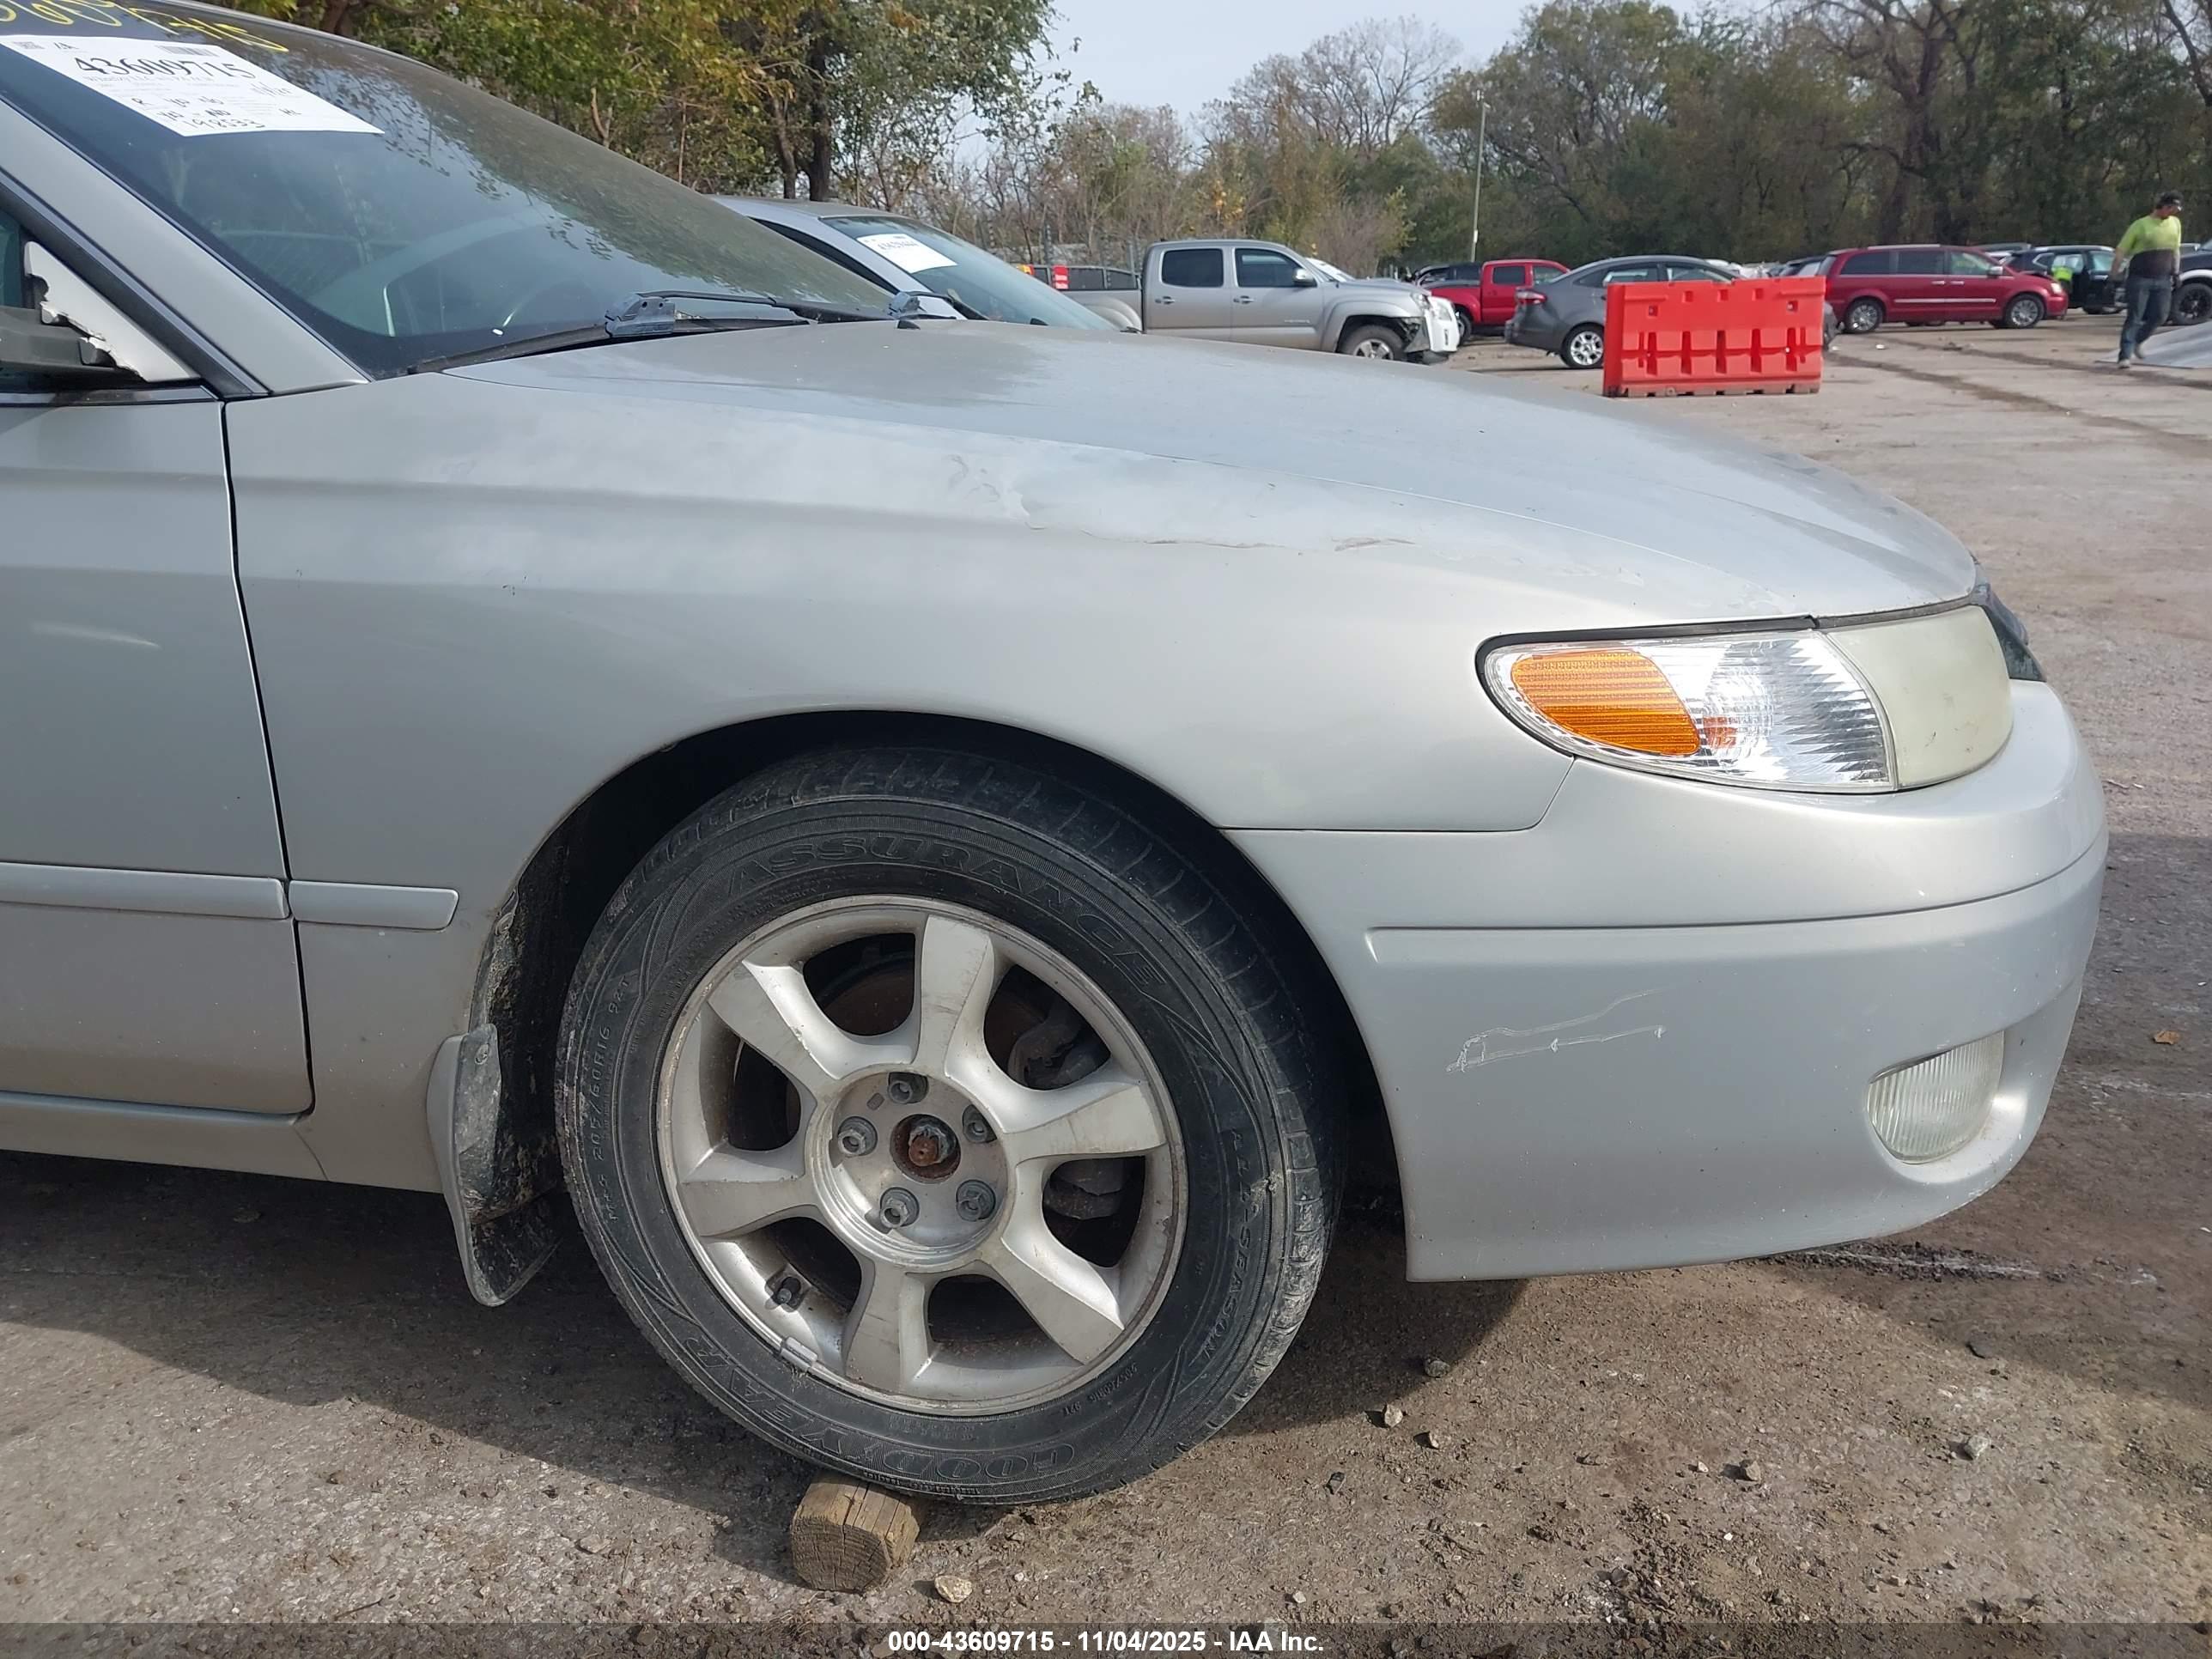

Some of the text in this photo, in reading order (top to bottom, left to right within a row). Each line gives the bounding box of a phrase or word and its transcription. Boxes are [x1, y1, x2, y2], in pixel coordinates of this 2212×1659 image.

[74, 57, 256, 79] 43609715
[727, 836, 1168, 987] ASSURANCE
[590, 1026, 611, 1161] 205/60R16
[608, 975, 630, 1014] 92T
[1203, 1128, 1251, 1360] ALL-SEASON
